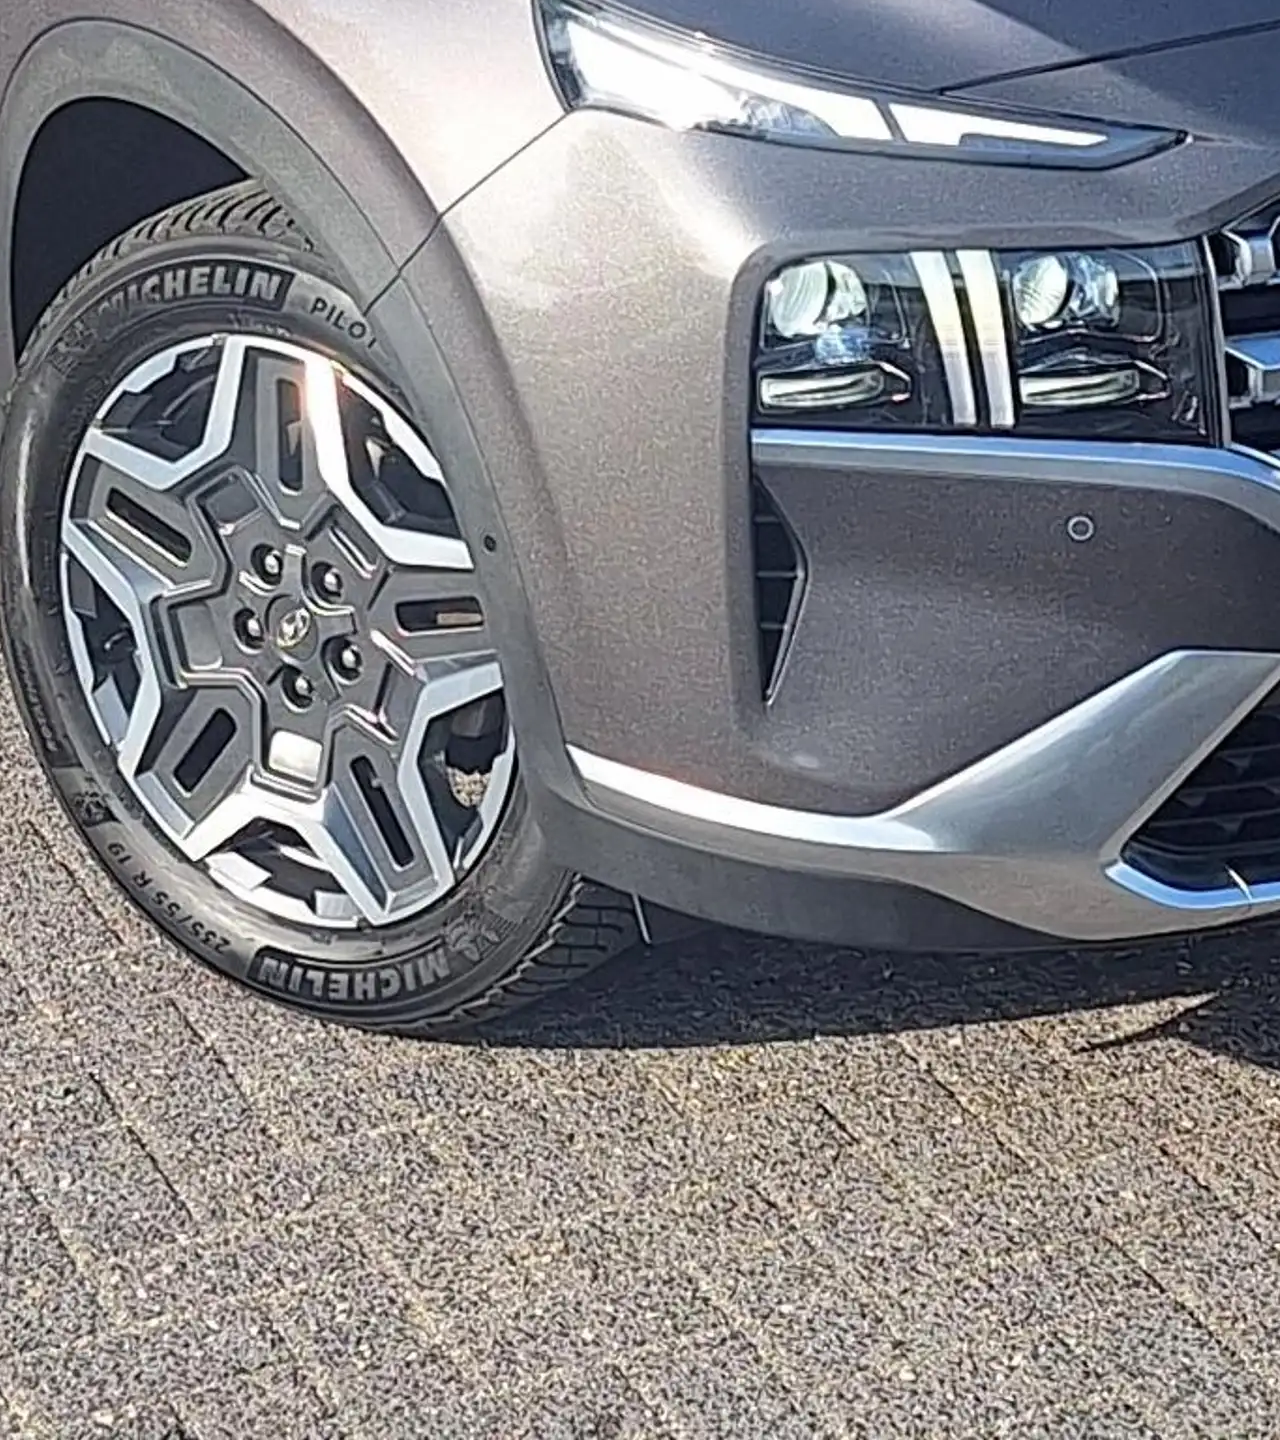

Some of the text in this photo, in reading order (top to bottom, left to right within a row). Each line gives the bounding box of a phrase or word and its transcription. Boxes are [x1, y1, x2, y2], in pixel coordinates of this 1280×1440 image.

[97, 264, 283, 319] MICHELIN
[107, 841, 232, 955] 235/55 R 19
[257, 946, 452, 1002] MICHELIN
